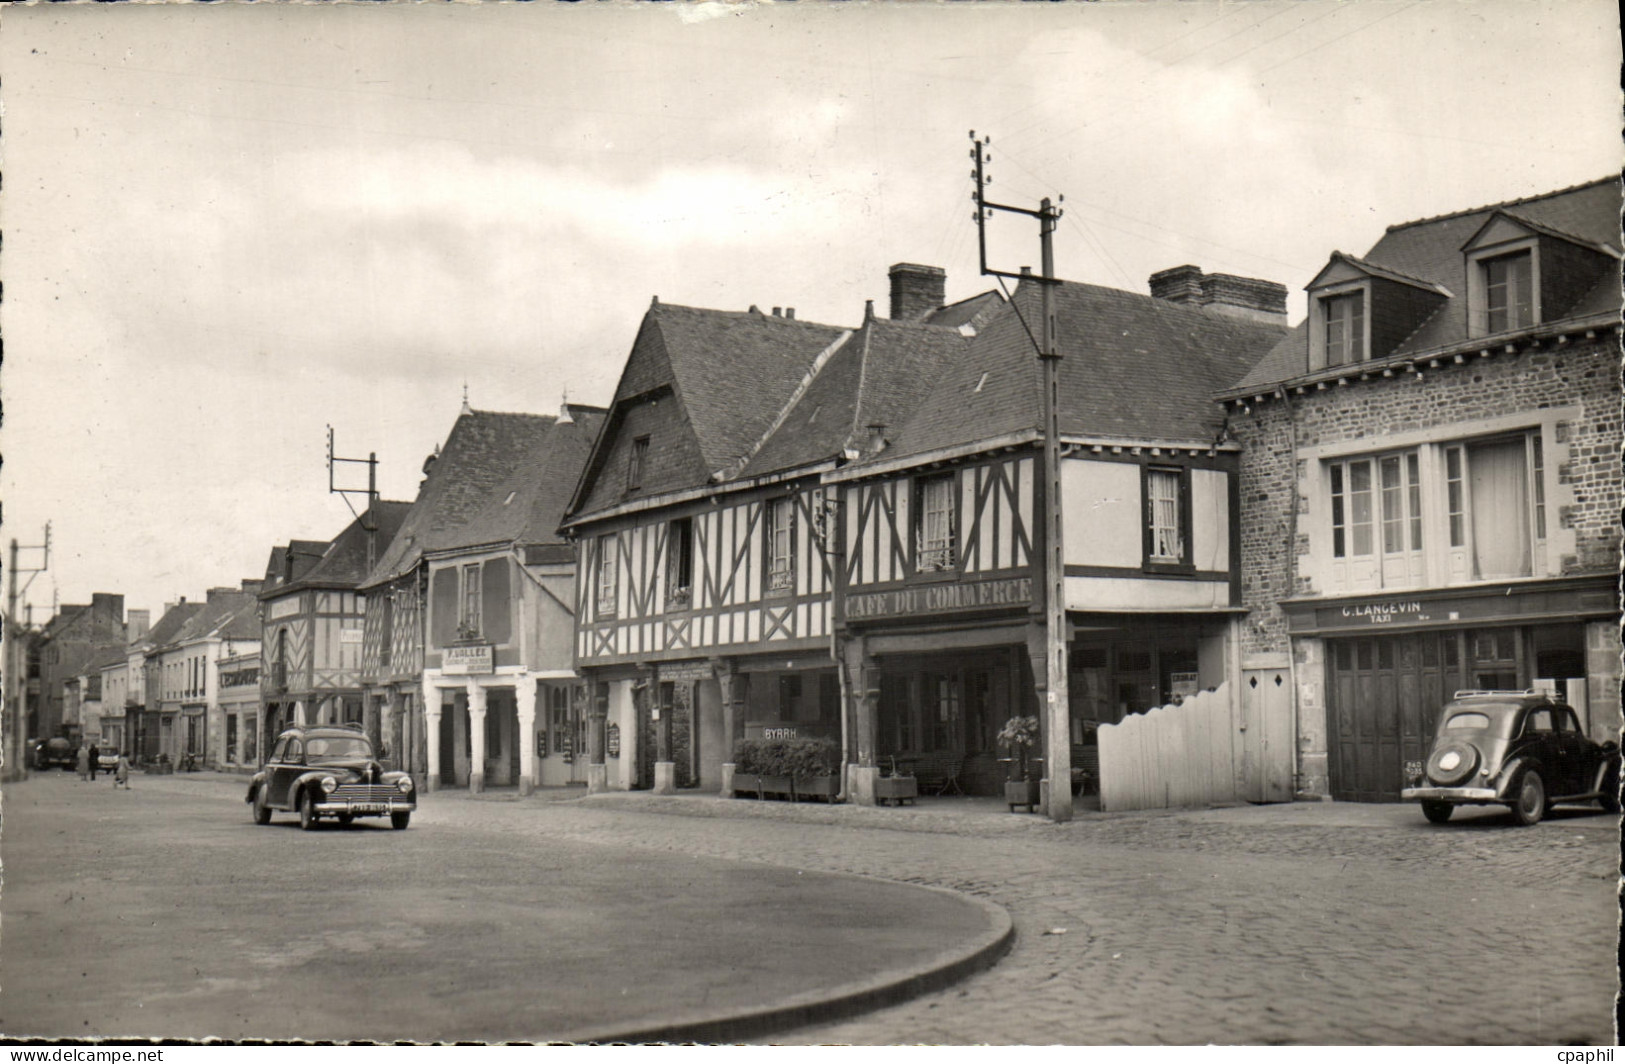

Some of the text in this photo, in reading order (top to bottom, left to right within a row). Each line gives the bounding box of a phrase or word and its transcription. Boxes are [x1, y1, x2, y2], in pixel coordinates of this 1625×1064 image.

[895, 590, 918, 614] DU
[926, 578, 1032, 610] COMMERCE
[1371, 614, 1391, 623] TAXI
[765, 728, 797, 740] BYRRH
